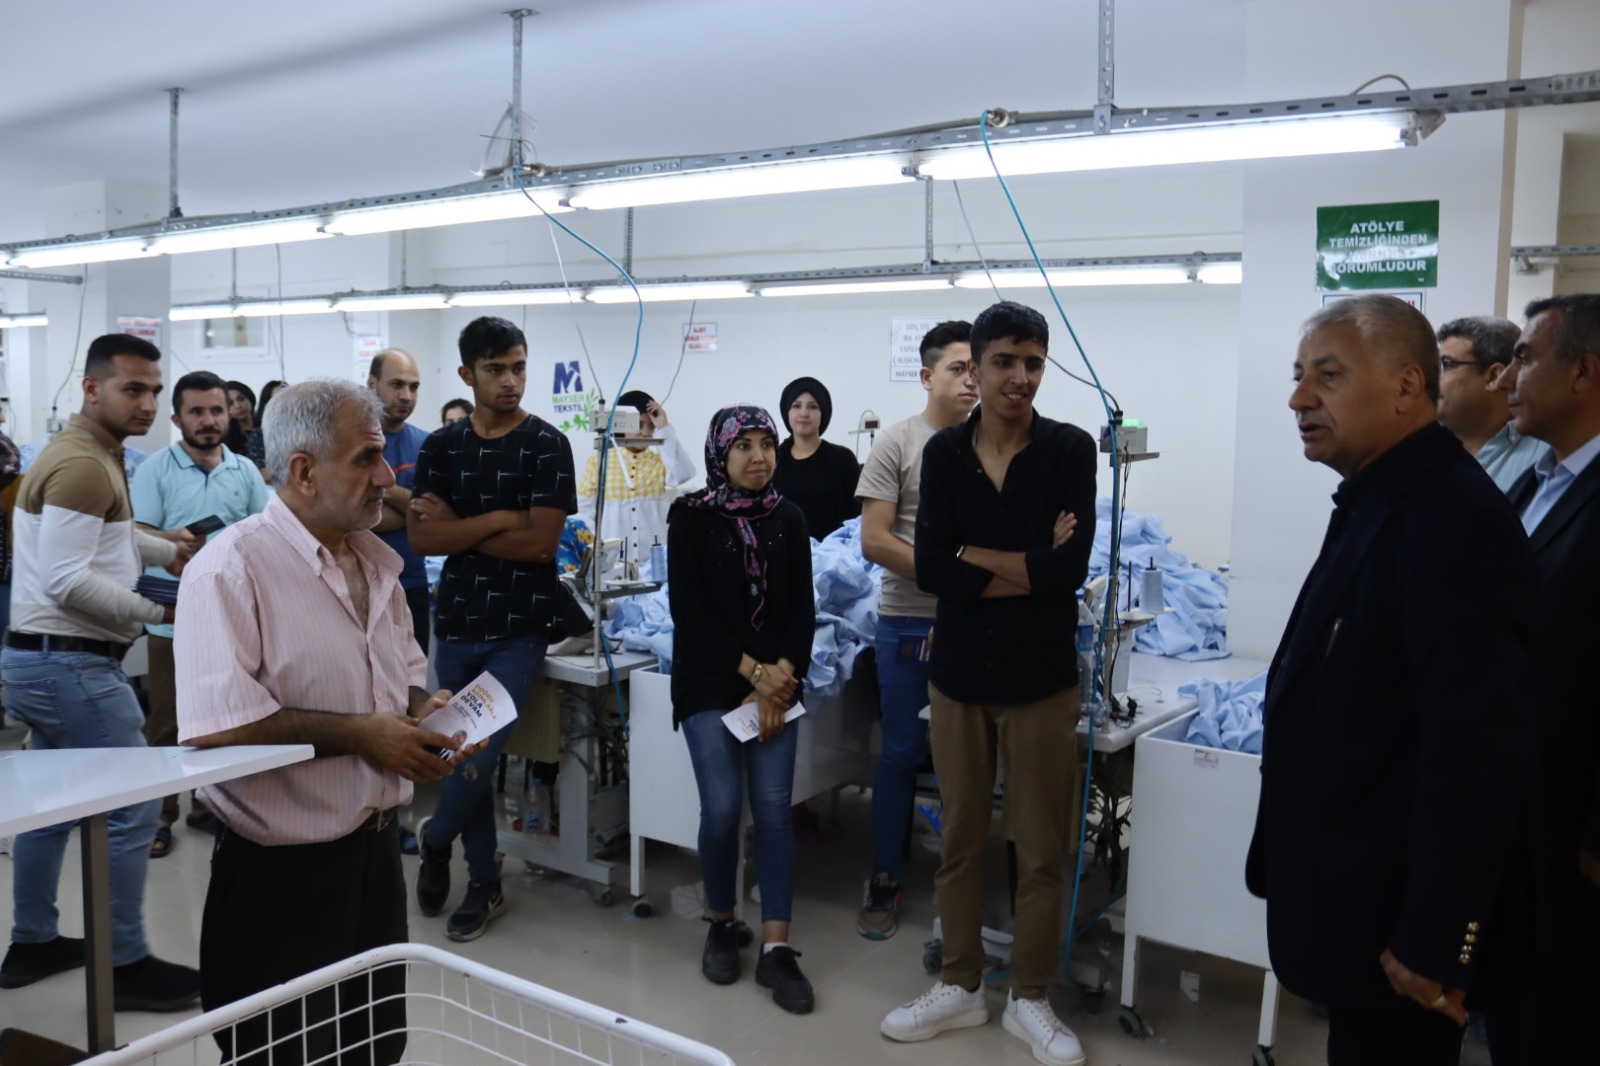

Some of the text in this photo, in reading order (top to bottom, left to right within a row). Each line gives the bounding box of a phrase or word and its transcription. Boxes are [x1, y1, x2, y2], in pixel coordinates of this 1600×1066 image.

[1350, 220, 1404, 234] ATÖLYE
[1329, 234, 1428, 248] TEMİZLİĞİNDEN
[895, 370, 918, 378] MAYSER
[552, 394, 584, 403] MAYSER
[460, 695, 482, 718] DEVAM
[466, 691, 483, 708] YOLA
